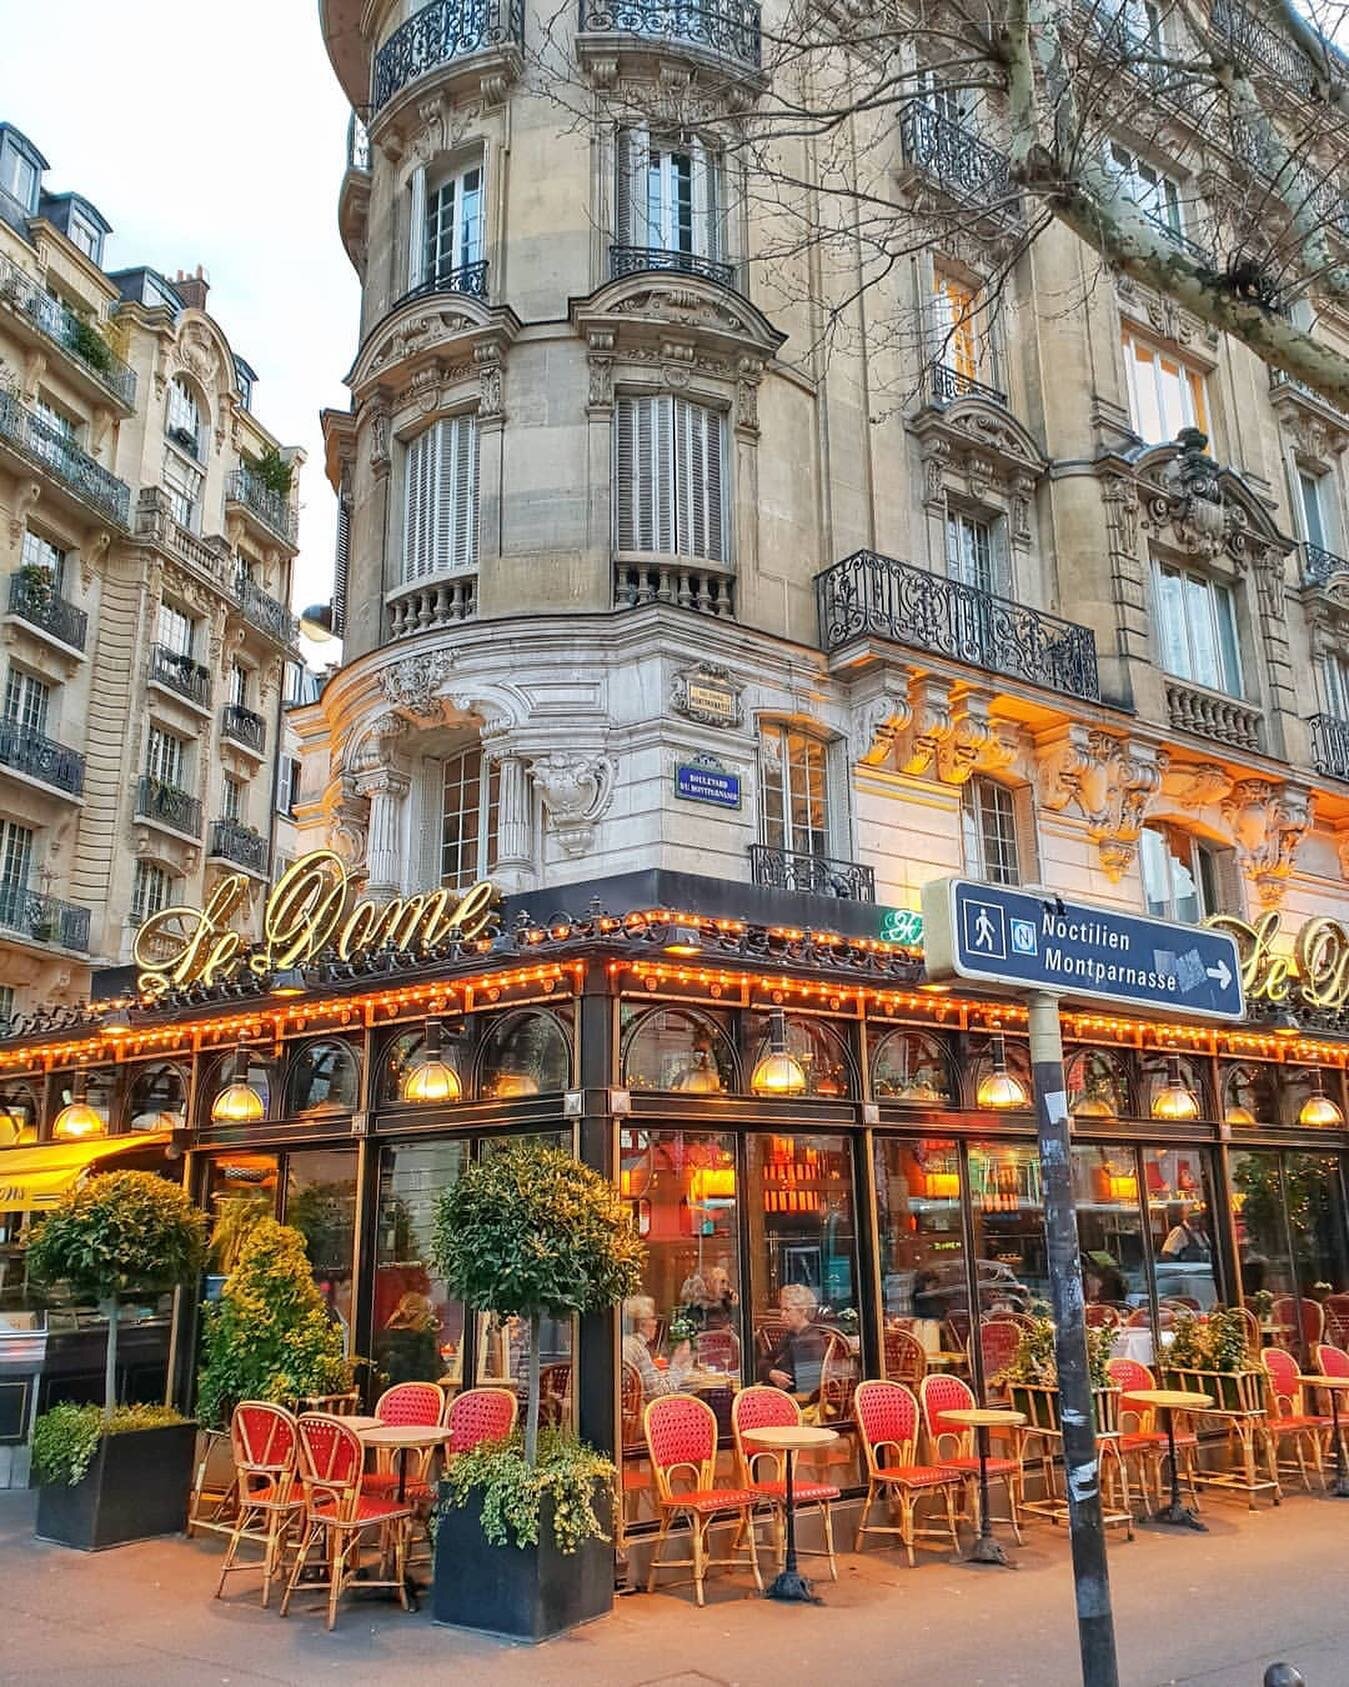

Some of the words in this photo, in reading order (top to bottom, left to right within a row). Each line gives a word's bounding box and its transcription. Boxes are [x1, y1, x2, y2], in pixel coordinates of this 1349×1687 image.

[134, 873, 246, 992] Le
[1042, 912, 1130, 951] Noctilien
[1045, 947, 1177, 991] Montparnasse
